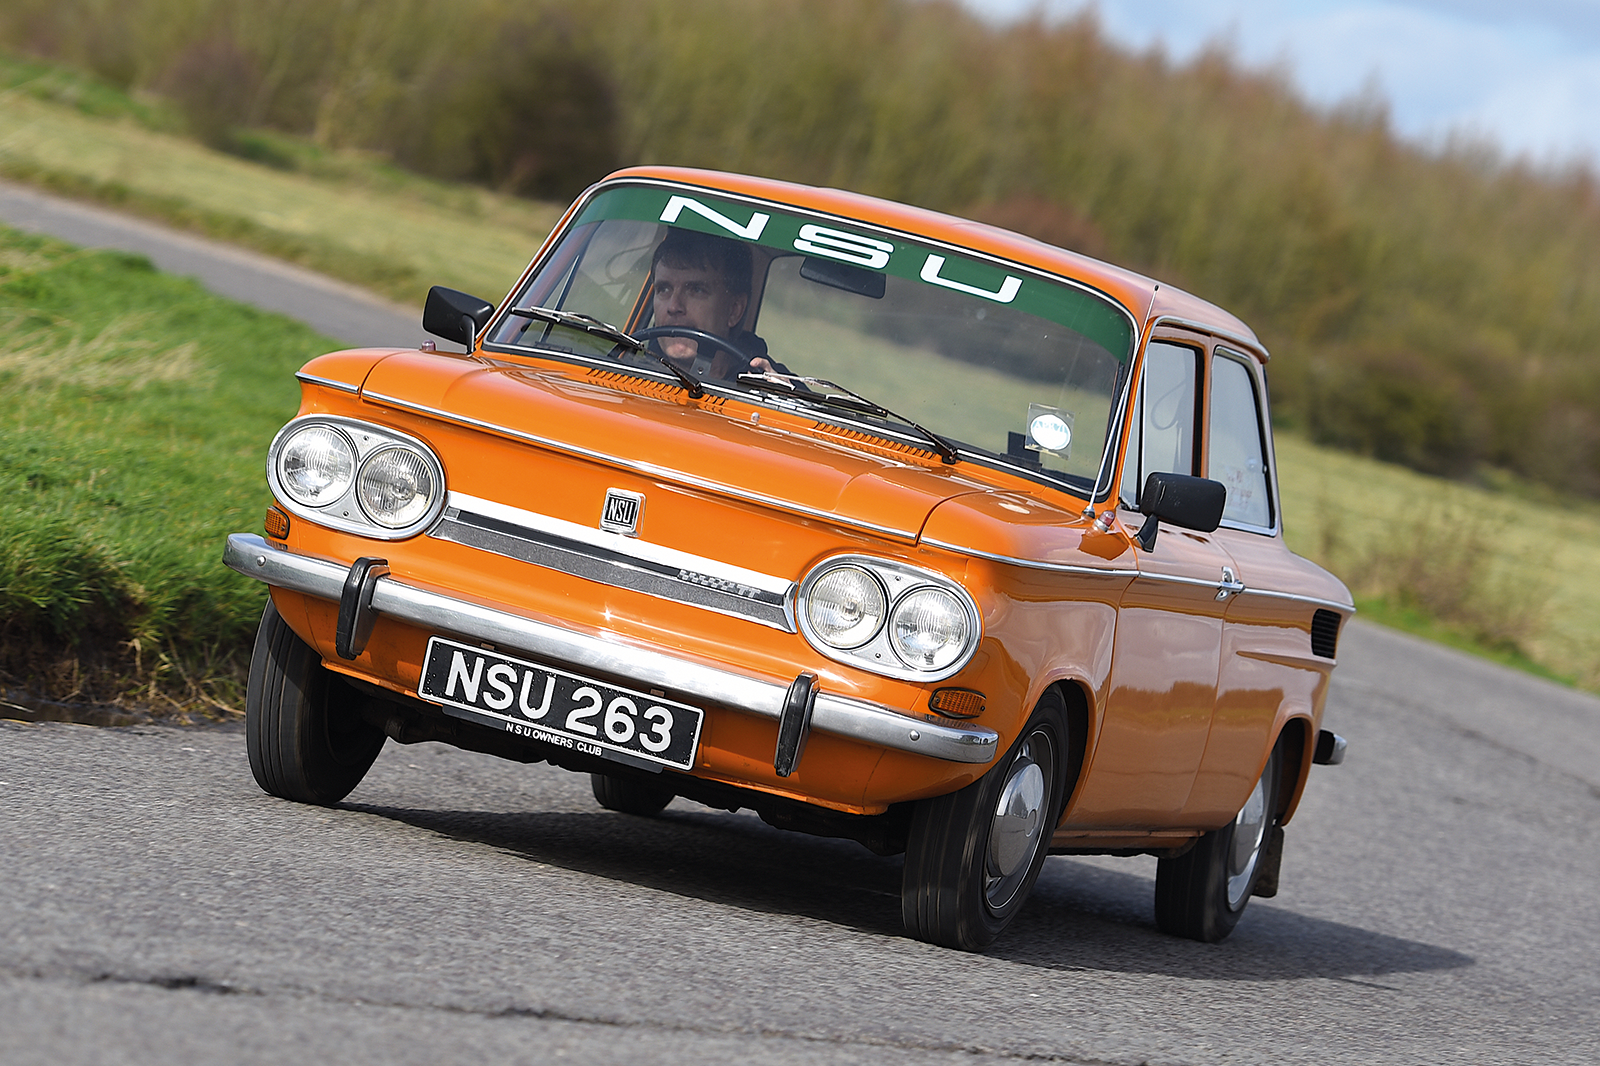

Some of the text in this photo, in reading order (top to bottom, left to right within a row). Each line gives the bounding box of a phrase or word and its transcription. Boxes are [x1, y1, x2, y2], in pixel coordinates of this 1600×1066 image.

[659, 195, 1023, 303] NSU
[607, 498, 634, 524] NSU
[444, 650, 674, 752] NSU 263
[532, 730, 574, 749] OWNERS
[577, 742, 603, 756] CLUB
